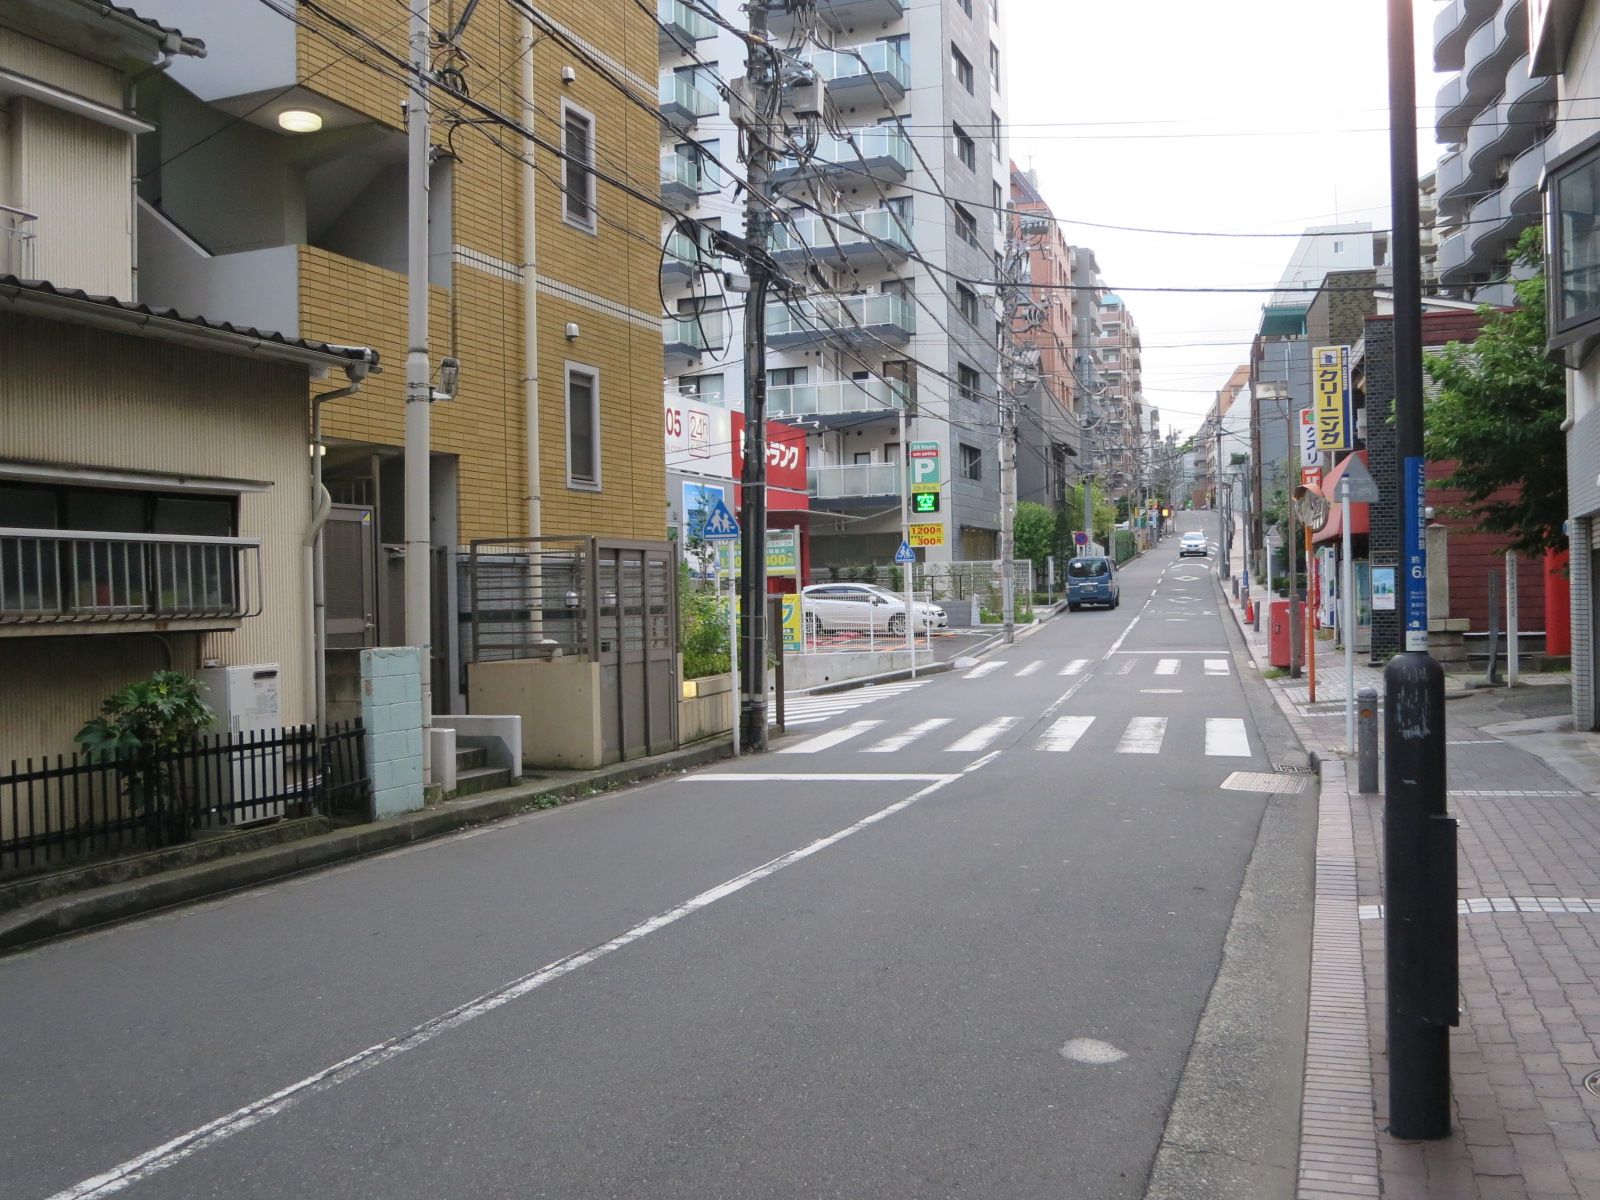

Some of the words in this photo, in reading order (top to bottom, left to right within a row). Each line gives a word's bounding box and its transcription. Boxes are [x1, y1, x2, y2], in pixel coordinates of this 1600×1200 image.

[1319, 369, 1340, 445] クリーニング
[915, 458, 935, 483] P
